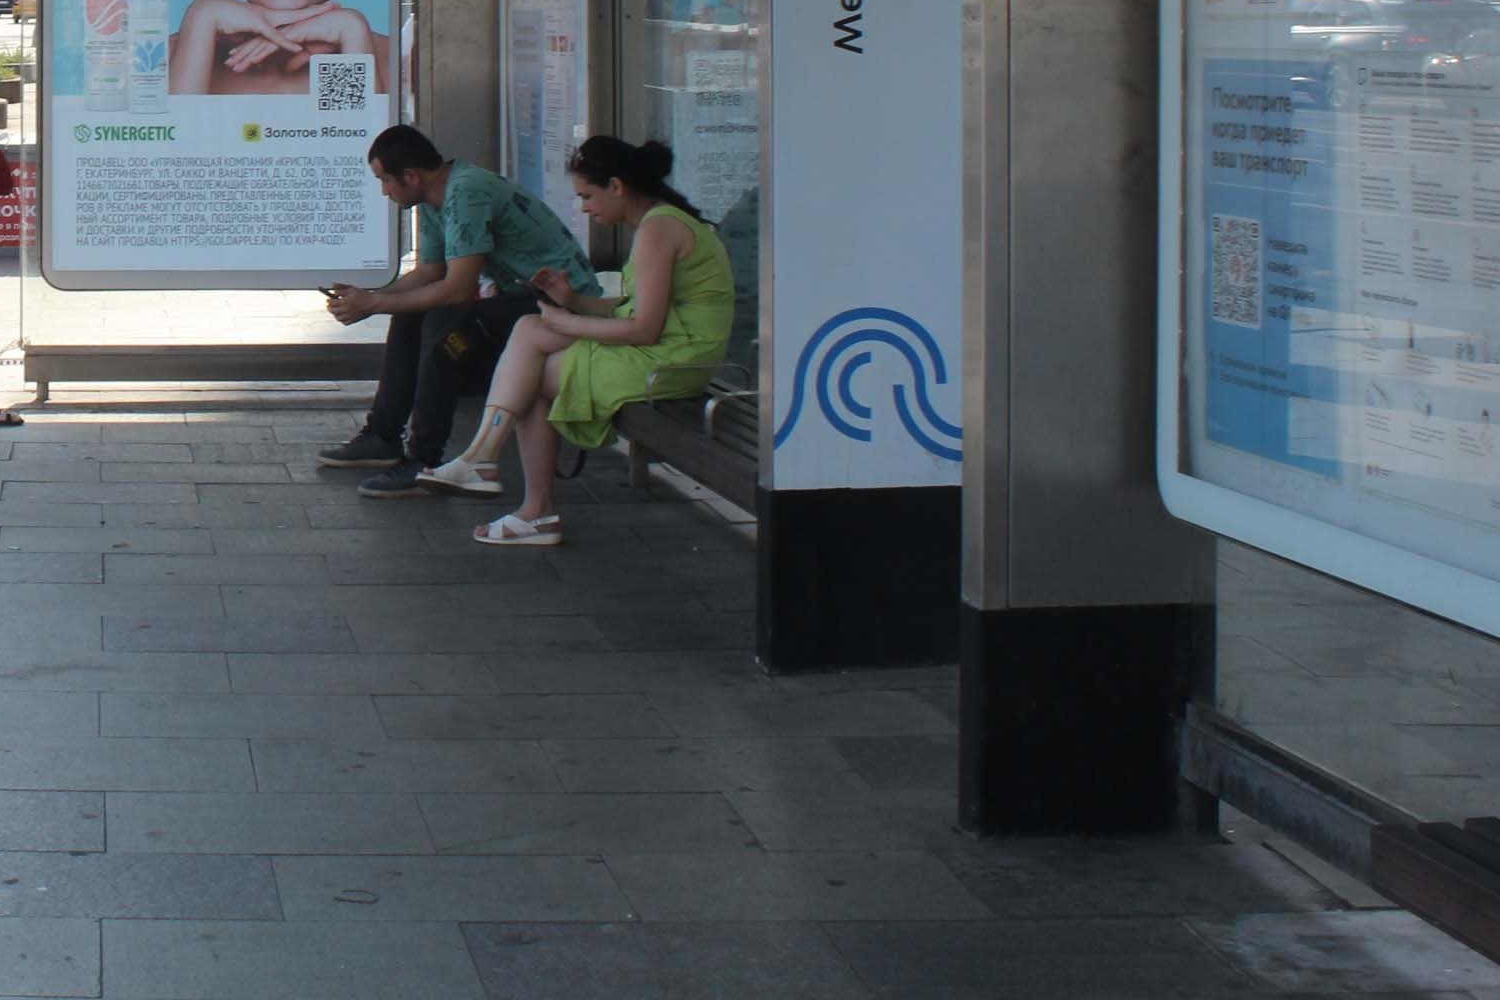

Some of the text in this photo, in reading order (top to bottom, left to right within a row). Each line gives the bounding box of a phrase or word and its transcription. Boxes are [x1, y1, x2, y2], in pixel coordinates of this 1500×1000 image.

[94, 126, 177, 142] SYNERGETIC
[264, 126, 368, 139] Золотое Яблоко
